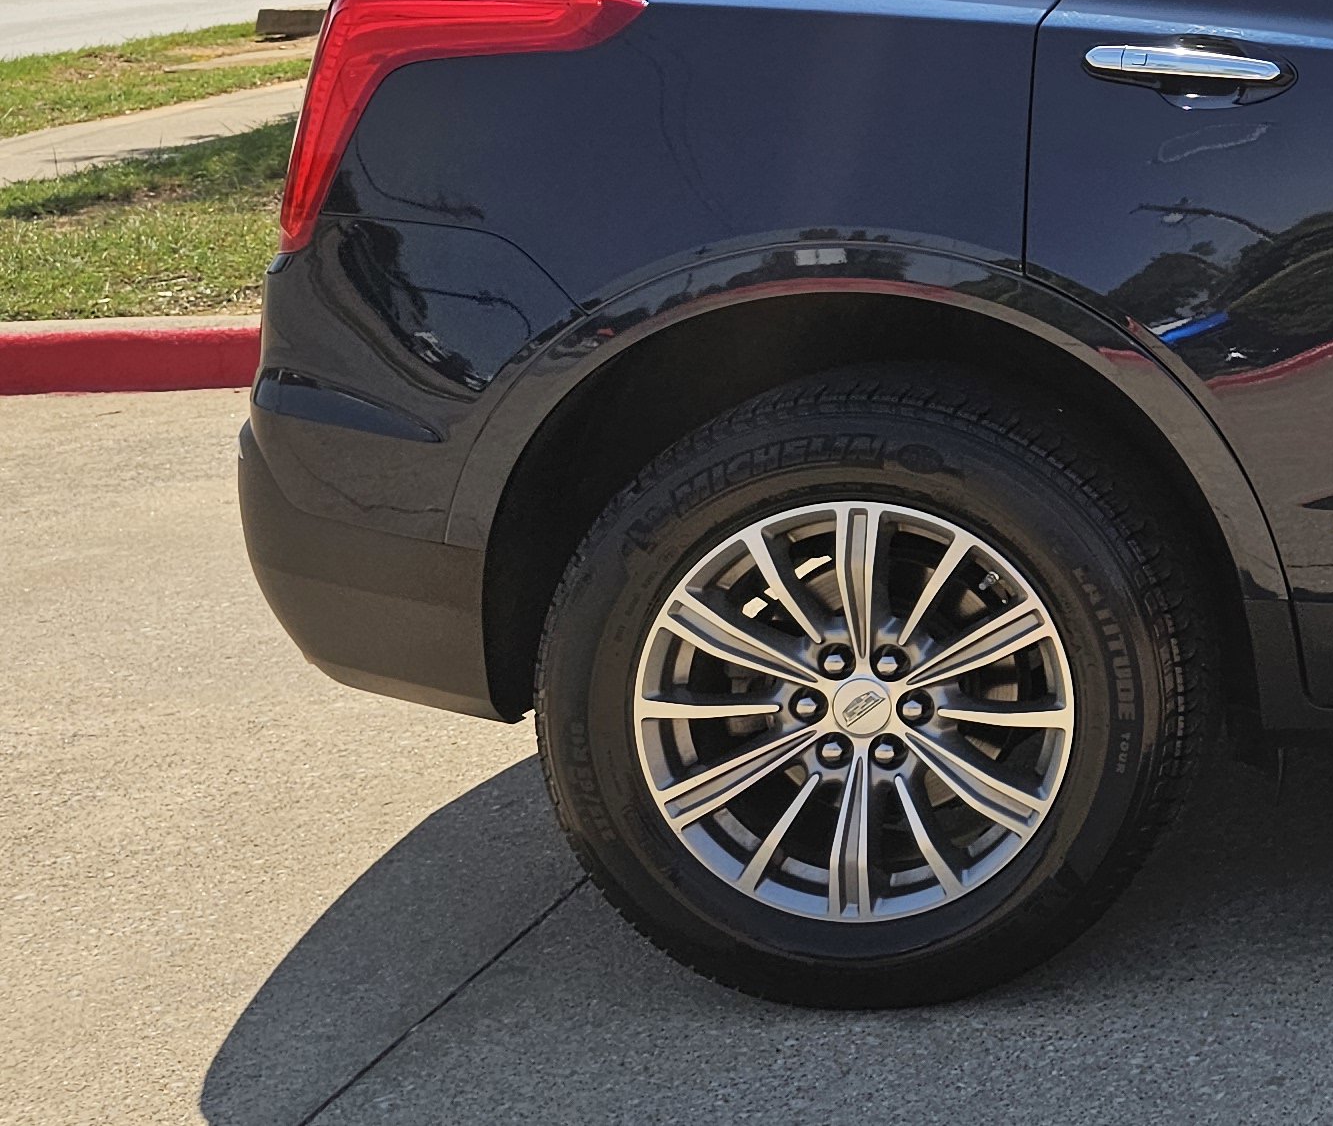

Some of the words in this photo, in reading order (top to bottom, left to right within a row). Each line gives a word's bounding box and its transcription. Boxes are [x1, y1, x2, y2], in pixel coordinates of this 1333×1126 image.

[671, 434, 883, 517] MICHELIN
[1072, 567, 1136, 721] LATITUDE
[1116, 731, 1132, 775] TOUR
